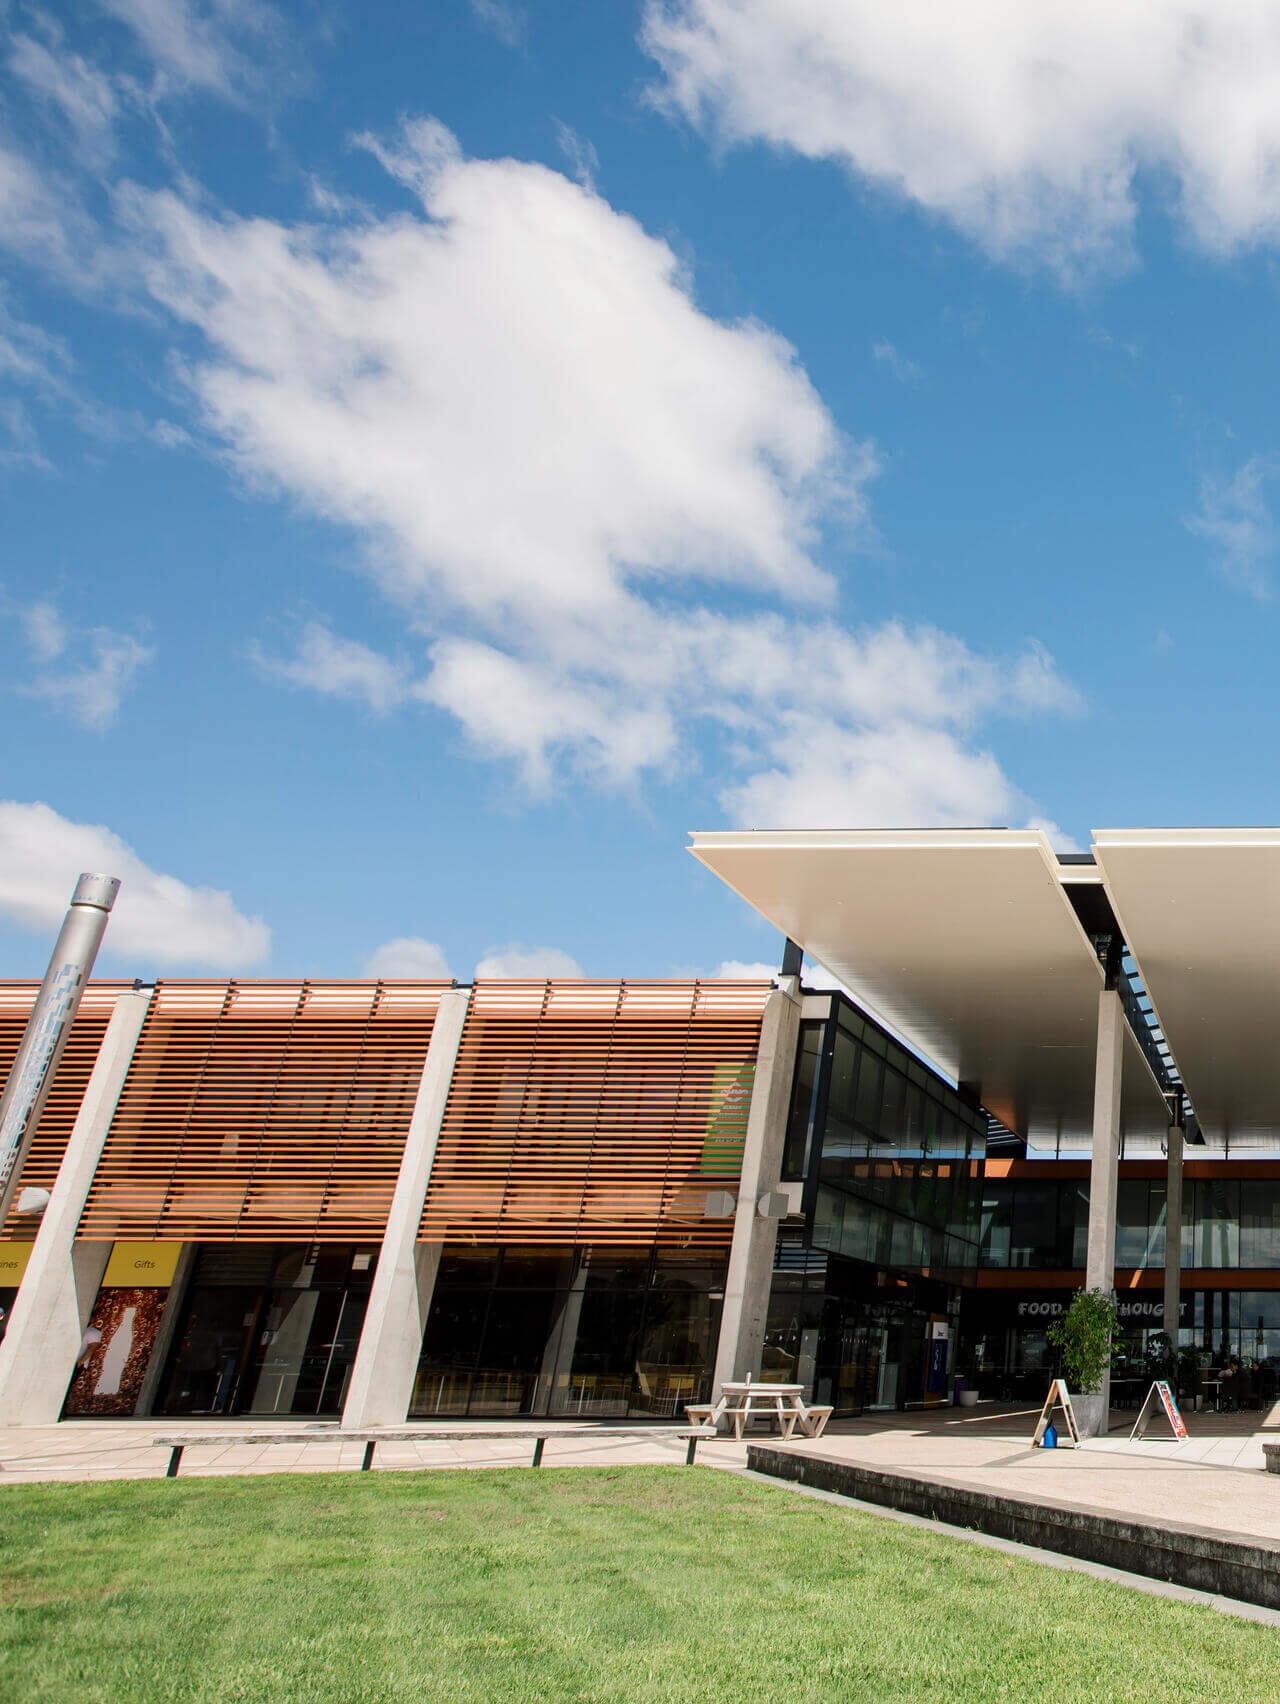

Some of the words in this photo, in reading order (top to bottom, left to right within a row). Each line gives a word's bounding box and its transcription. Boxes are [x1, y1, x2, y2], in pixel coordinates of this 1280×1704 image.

[134, 1259, 156, 1269] Gifts
[1017, 1302, 1062, 1316] FOOD
[1114, 1302, 1187, 1317] THOUGT
